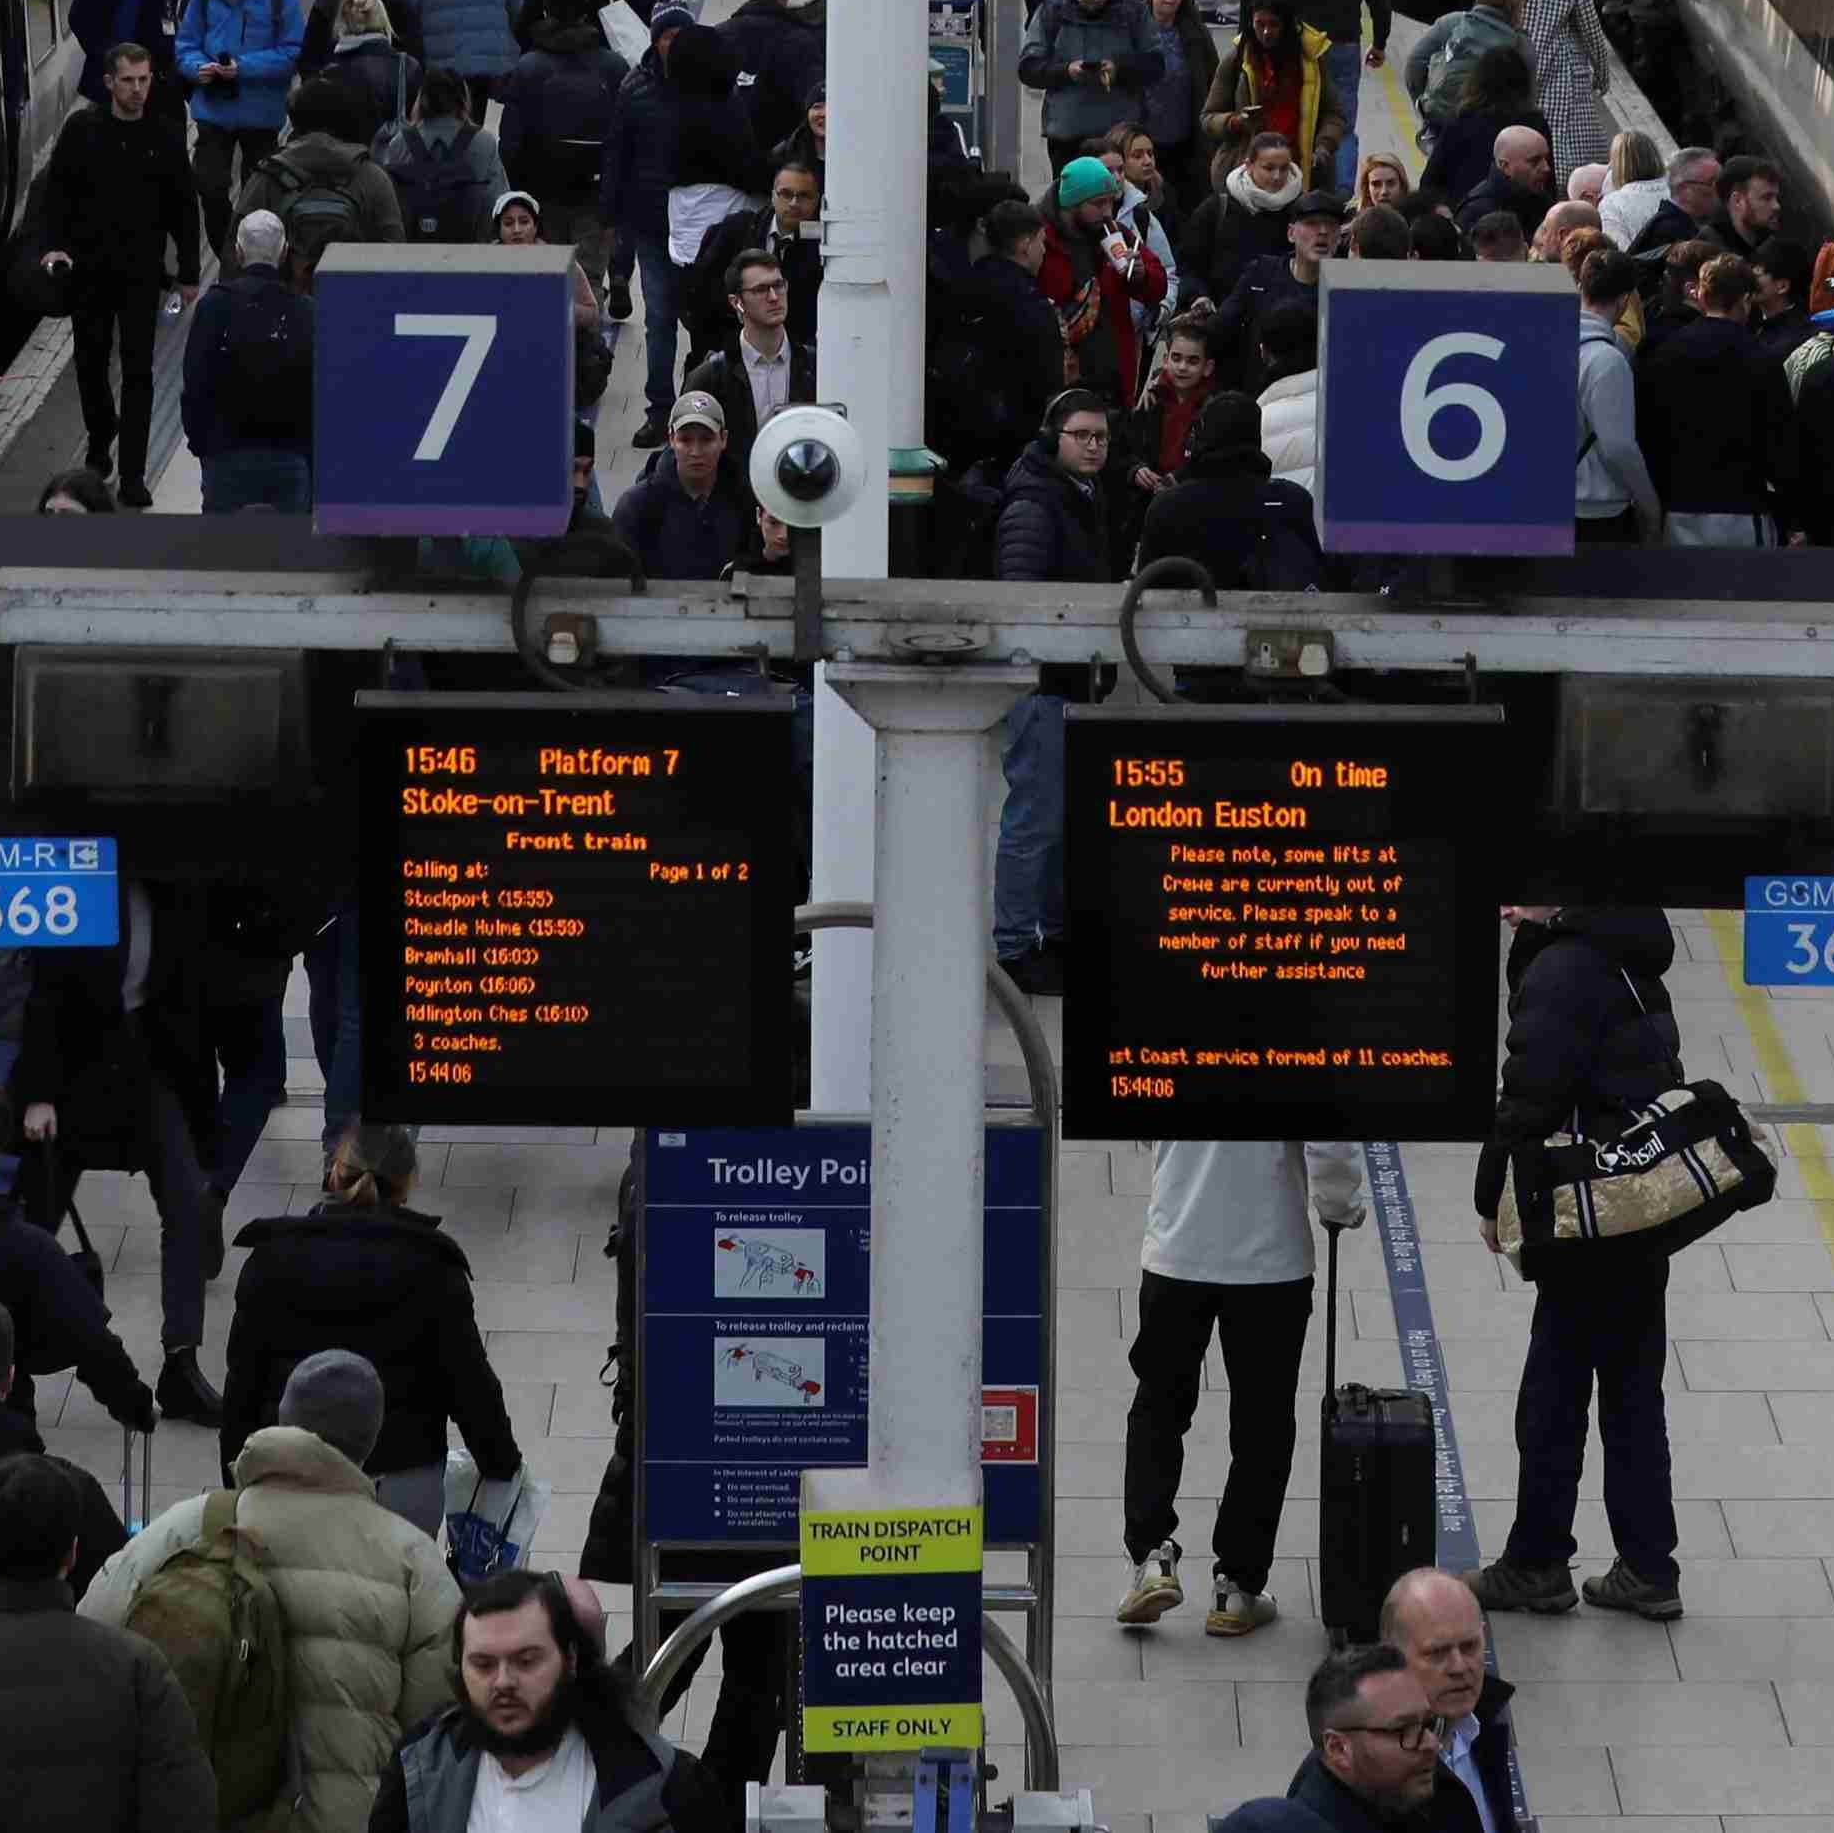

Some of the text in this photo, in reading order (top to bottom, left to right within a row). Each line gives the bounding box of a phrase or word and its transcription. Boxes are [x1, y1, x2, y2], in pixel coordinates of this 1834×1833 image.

[393, 314, 498, 460] 7
[1399, 332, 1507, 482] 6
[406, 746, 680, 776] 15:46 Platform 7
[1114, 758, 1388, 788] 15:55 On time
[402, 787, 616, 816] Stoke-on-Trent
[1109, 800, 1307, 828] London Euston
[506, 831, 648, 851] Front train
[1170, 844, 1397, 867] Please note, some lifts at
[403, 859, 488, 883] Calling at:
[649, 861, 749, 884] Page 1 of 2
[1162, 874, 1403, 897] Crewe are currently out of
[404, 889, 554, 911] Stockport (15:55)
[1168, 903, 1397, 925] service. Please speak to a
[404, 917, 469, 936] Cheadle
[474, 918, 522, 937] Hulme
[1159, 932, 1406, 955] member of staff if you need
[405, 946, 476, 966] Bramhall
[1201, 961, 1366, 980] further assistance
[405, 975, 473, 999] Poynton
[406, 1004, 589, 1026] Adlington Ches (16:10)
[414, 1032, 502, 1051] 3 coaches.
[1140, 1047, 1189, 1065] Coast
[1195, 1048, 1260, 1066] service
[1265, 1048, 1326, 1066] formed
[1332, 1049, 1352, 1066] of
[1358, 1048, 1375, 1066] 11
[1381, 1048, 1452, 1066] coaches.
[1110, 1075, 1175, 1098] 15:44:06
[708, 1158, 871, 1190] Trolley Poi
[715, 1212, 803, 1223] To release trolley
[715, 1321, 865, 1333] To release trolley and reclaim
[1404, 1328, 1432, 1347] Help
[1409, 1369, 1440, 1386] help
[809, 1518, 971, 1539] TRAIN DISPATCH
[860, 1544, 922, 1563] POINT
[826, 1602, 955, 1627] Please keep
[823, 1629, 958, 1651] the hatched
[836, 1657, 947, 1677] area clear
[832, 1718, 952, 1738] STAFF ONLY
